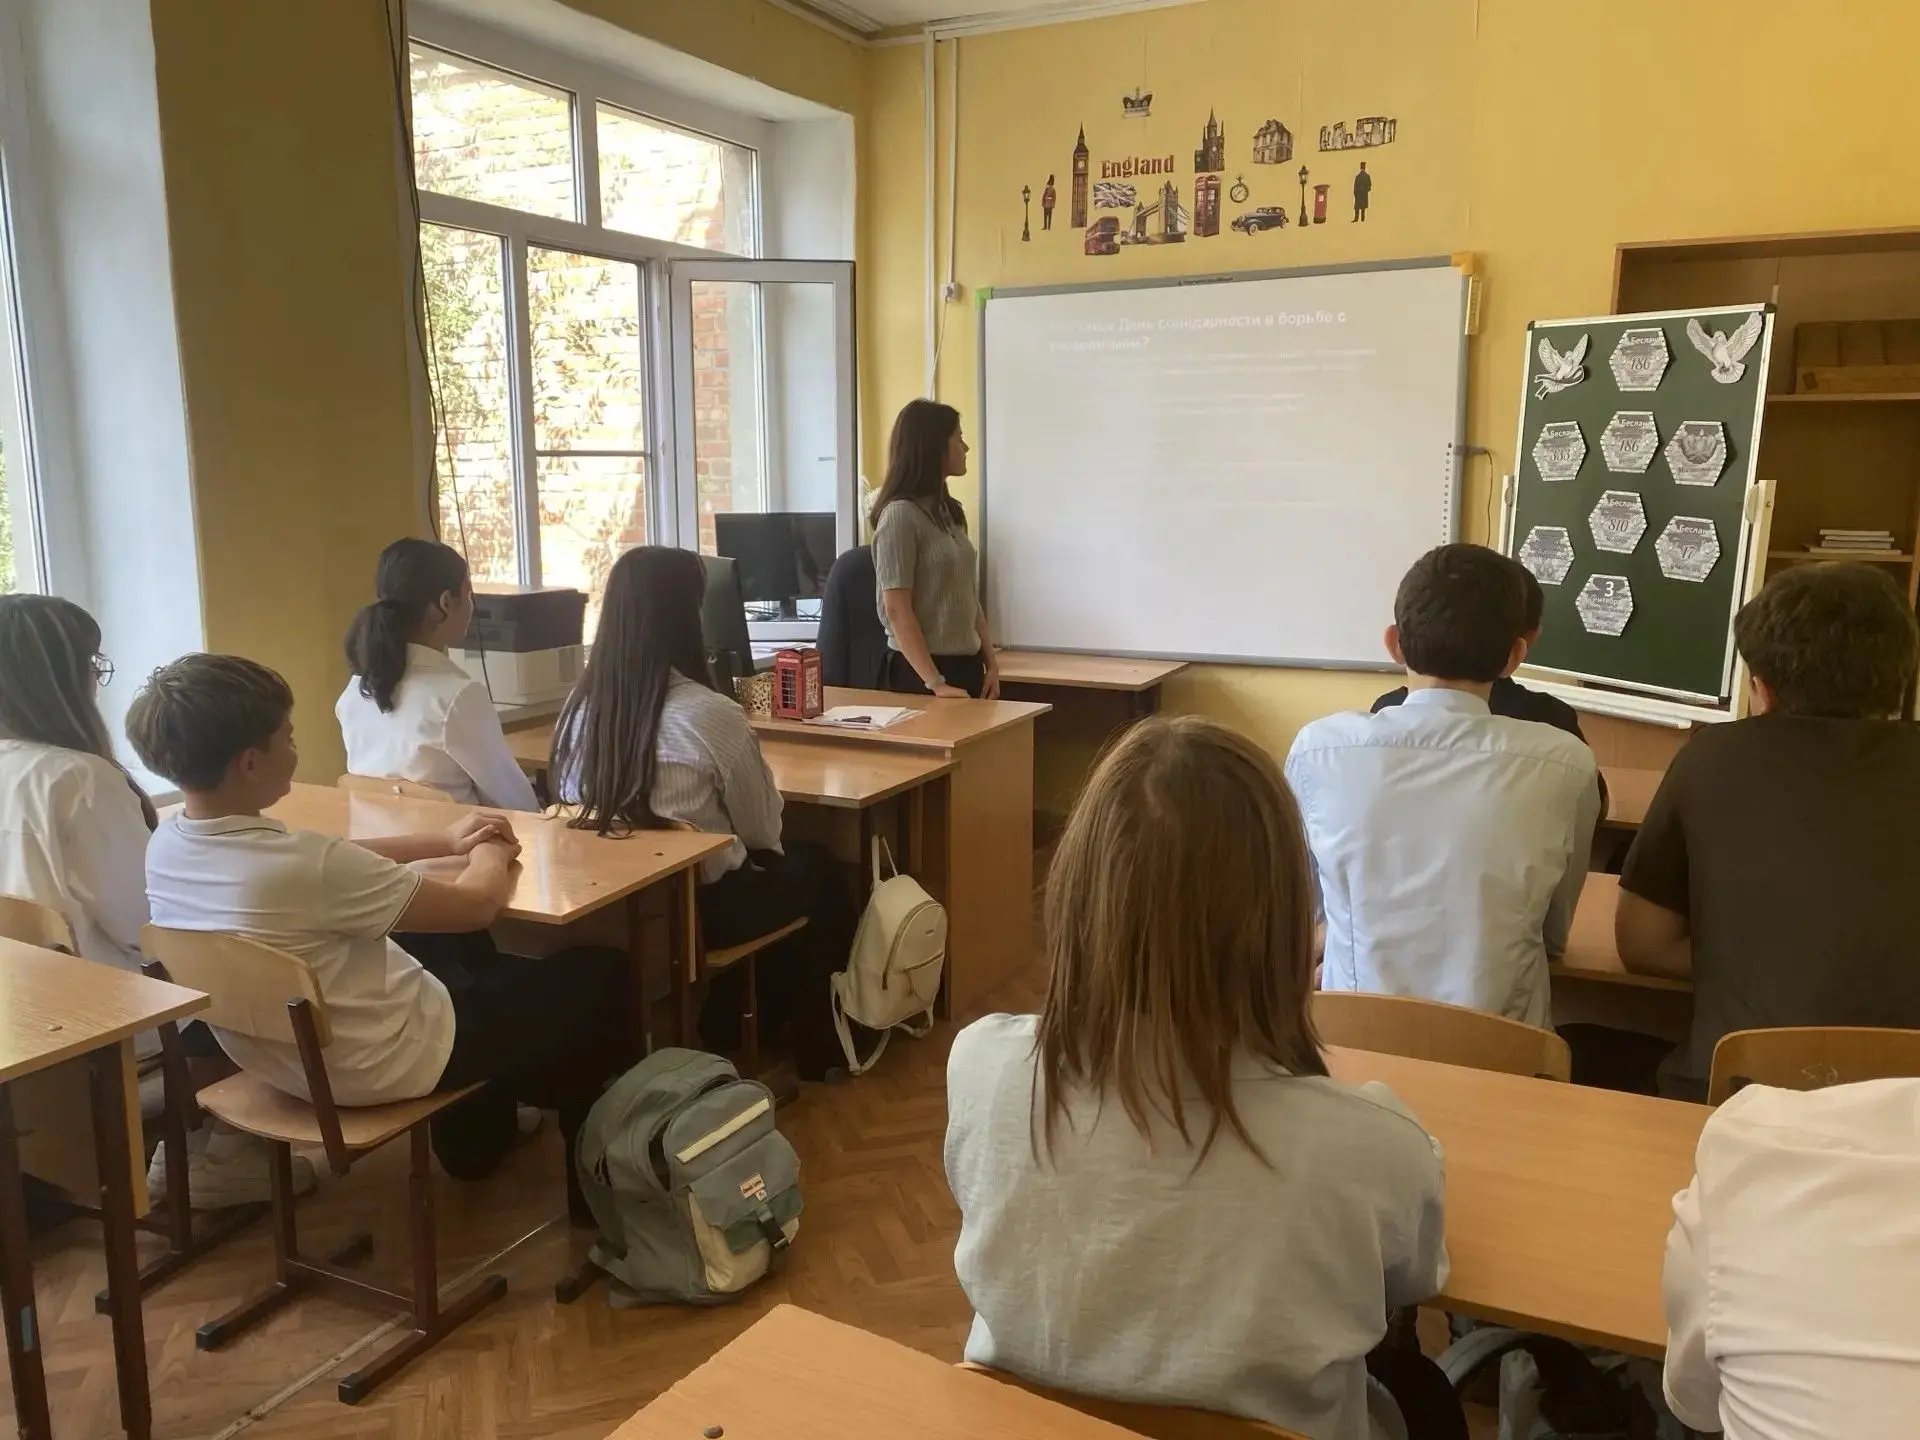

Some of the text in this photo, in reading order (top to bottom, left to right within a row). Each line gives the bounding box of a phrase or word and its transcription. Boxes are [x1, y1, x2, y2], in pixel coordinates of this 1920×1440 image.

[1101, 154, 1174, 178] England
[1278, 308, 1333, 324] борьбе
[1338, 310, 1348, 322] с
[1630, 356, 1651, 370] 186
[1619, 439, 1639, 452] 186
[1549, 448, 1571, 462] 333
[1608, 518, 1629, 531] 810
[1682, 546, 1696, 559] 17
[1604, 581, 1614, 597] 3
